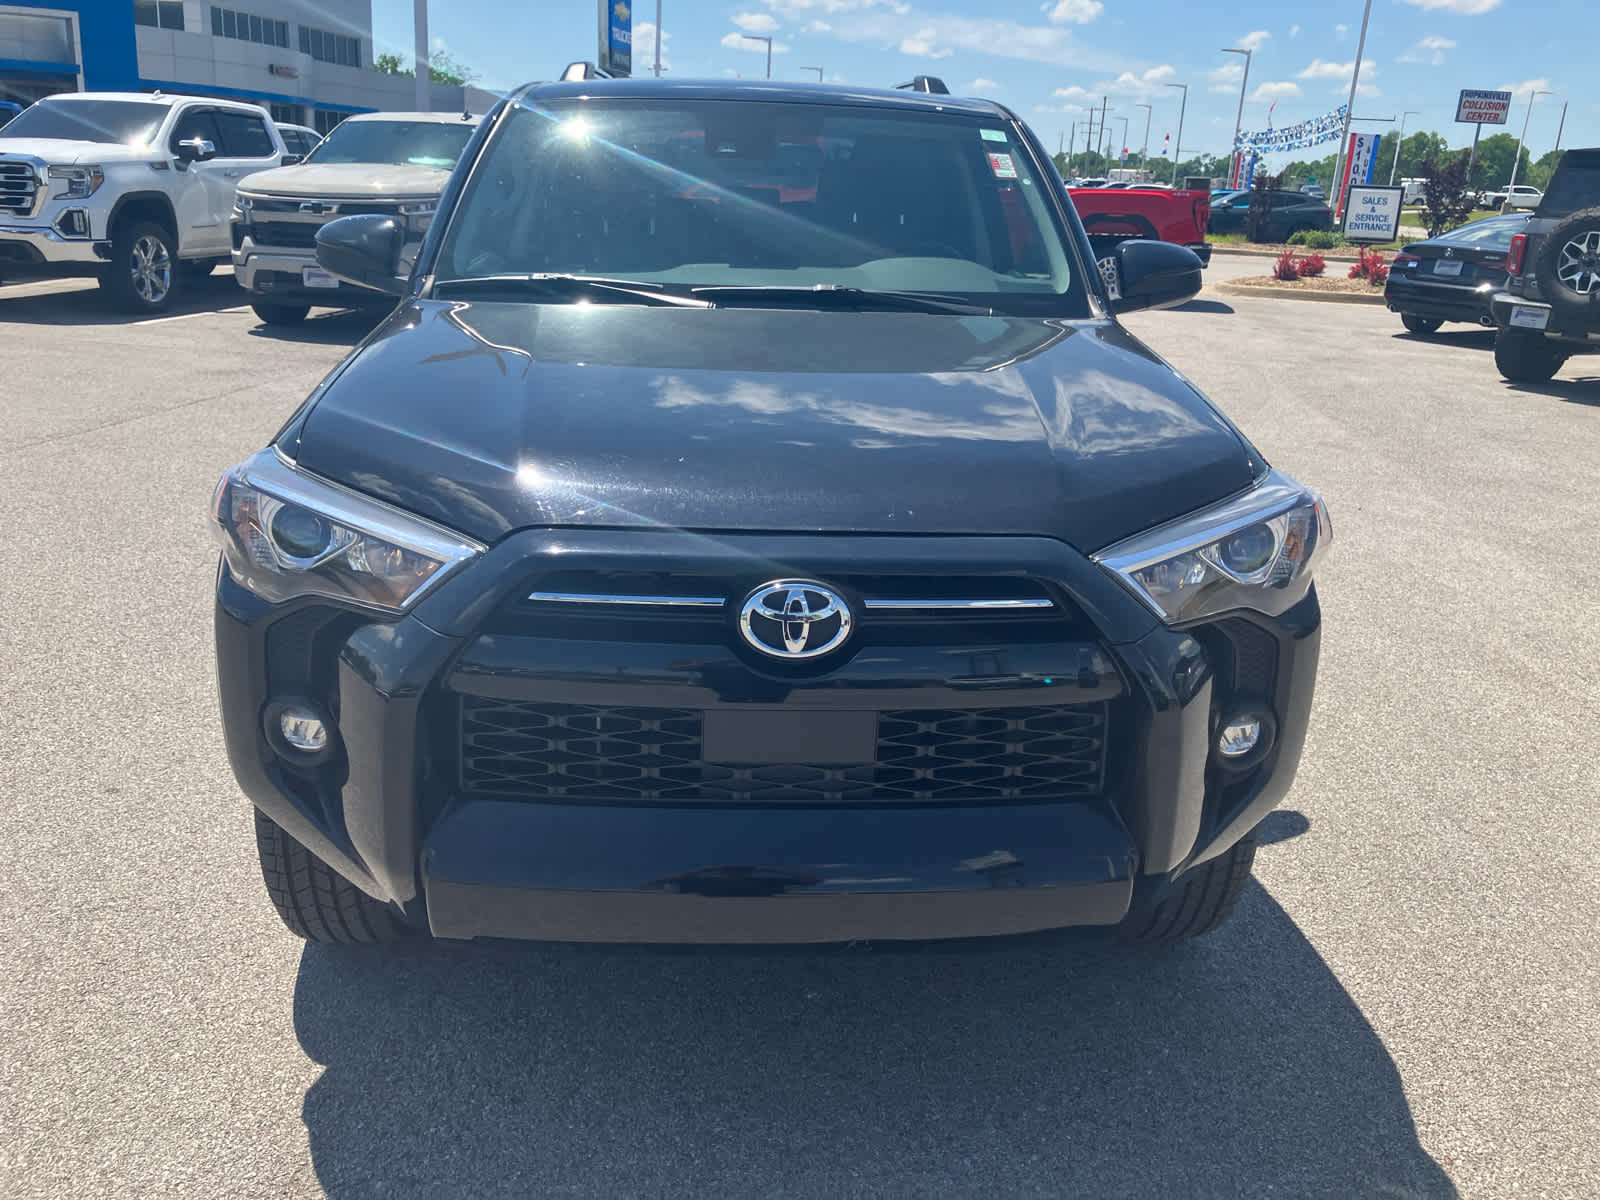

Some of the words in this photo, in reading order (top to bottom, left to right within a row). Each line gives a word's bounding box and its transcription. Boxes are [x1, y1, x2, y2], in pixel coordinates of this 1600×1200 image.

[1462, 100, 1508, 112] COLLISION
[1466, 112, 1500, 121] CENTER
[1362, 196, 1388, 206] SALES
[1355, 214, 1390, 222] SERVICE
[1349, 222, 1392, 232] ENTRANCE
